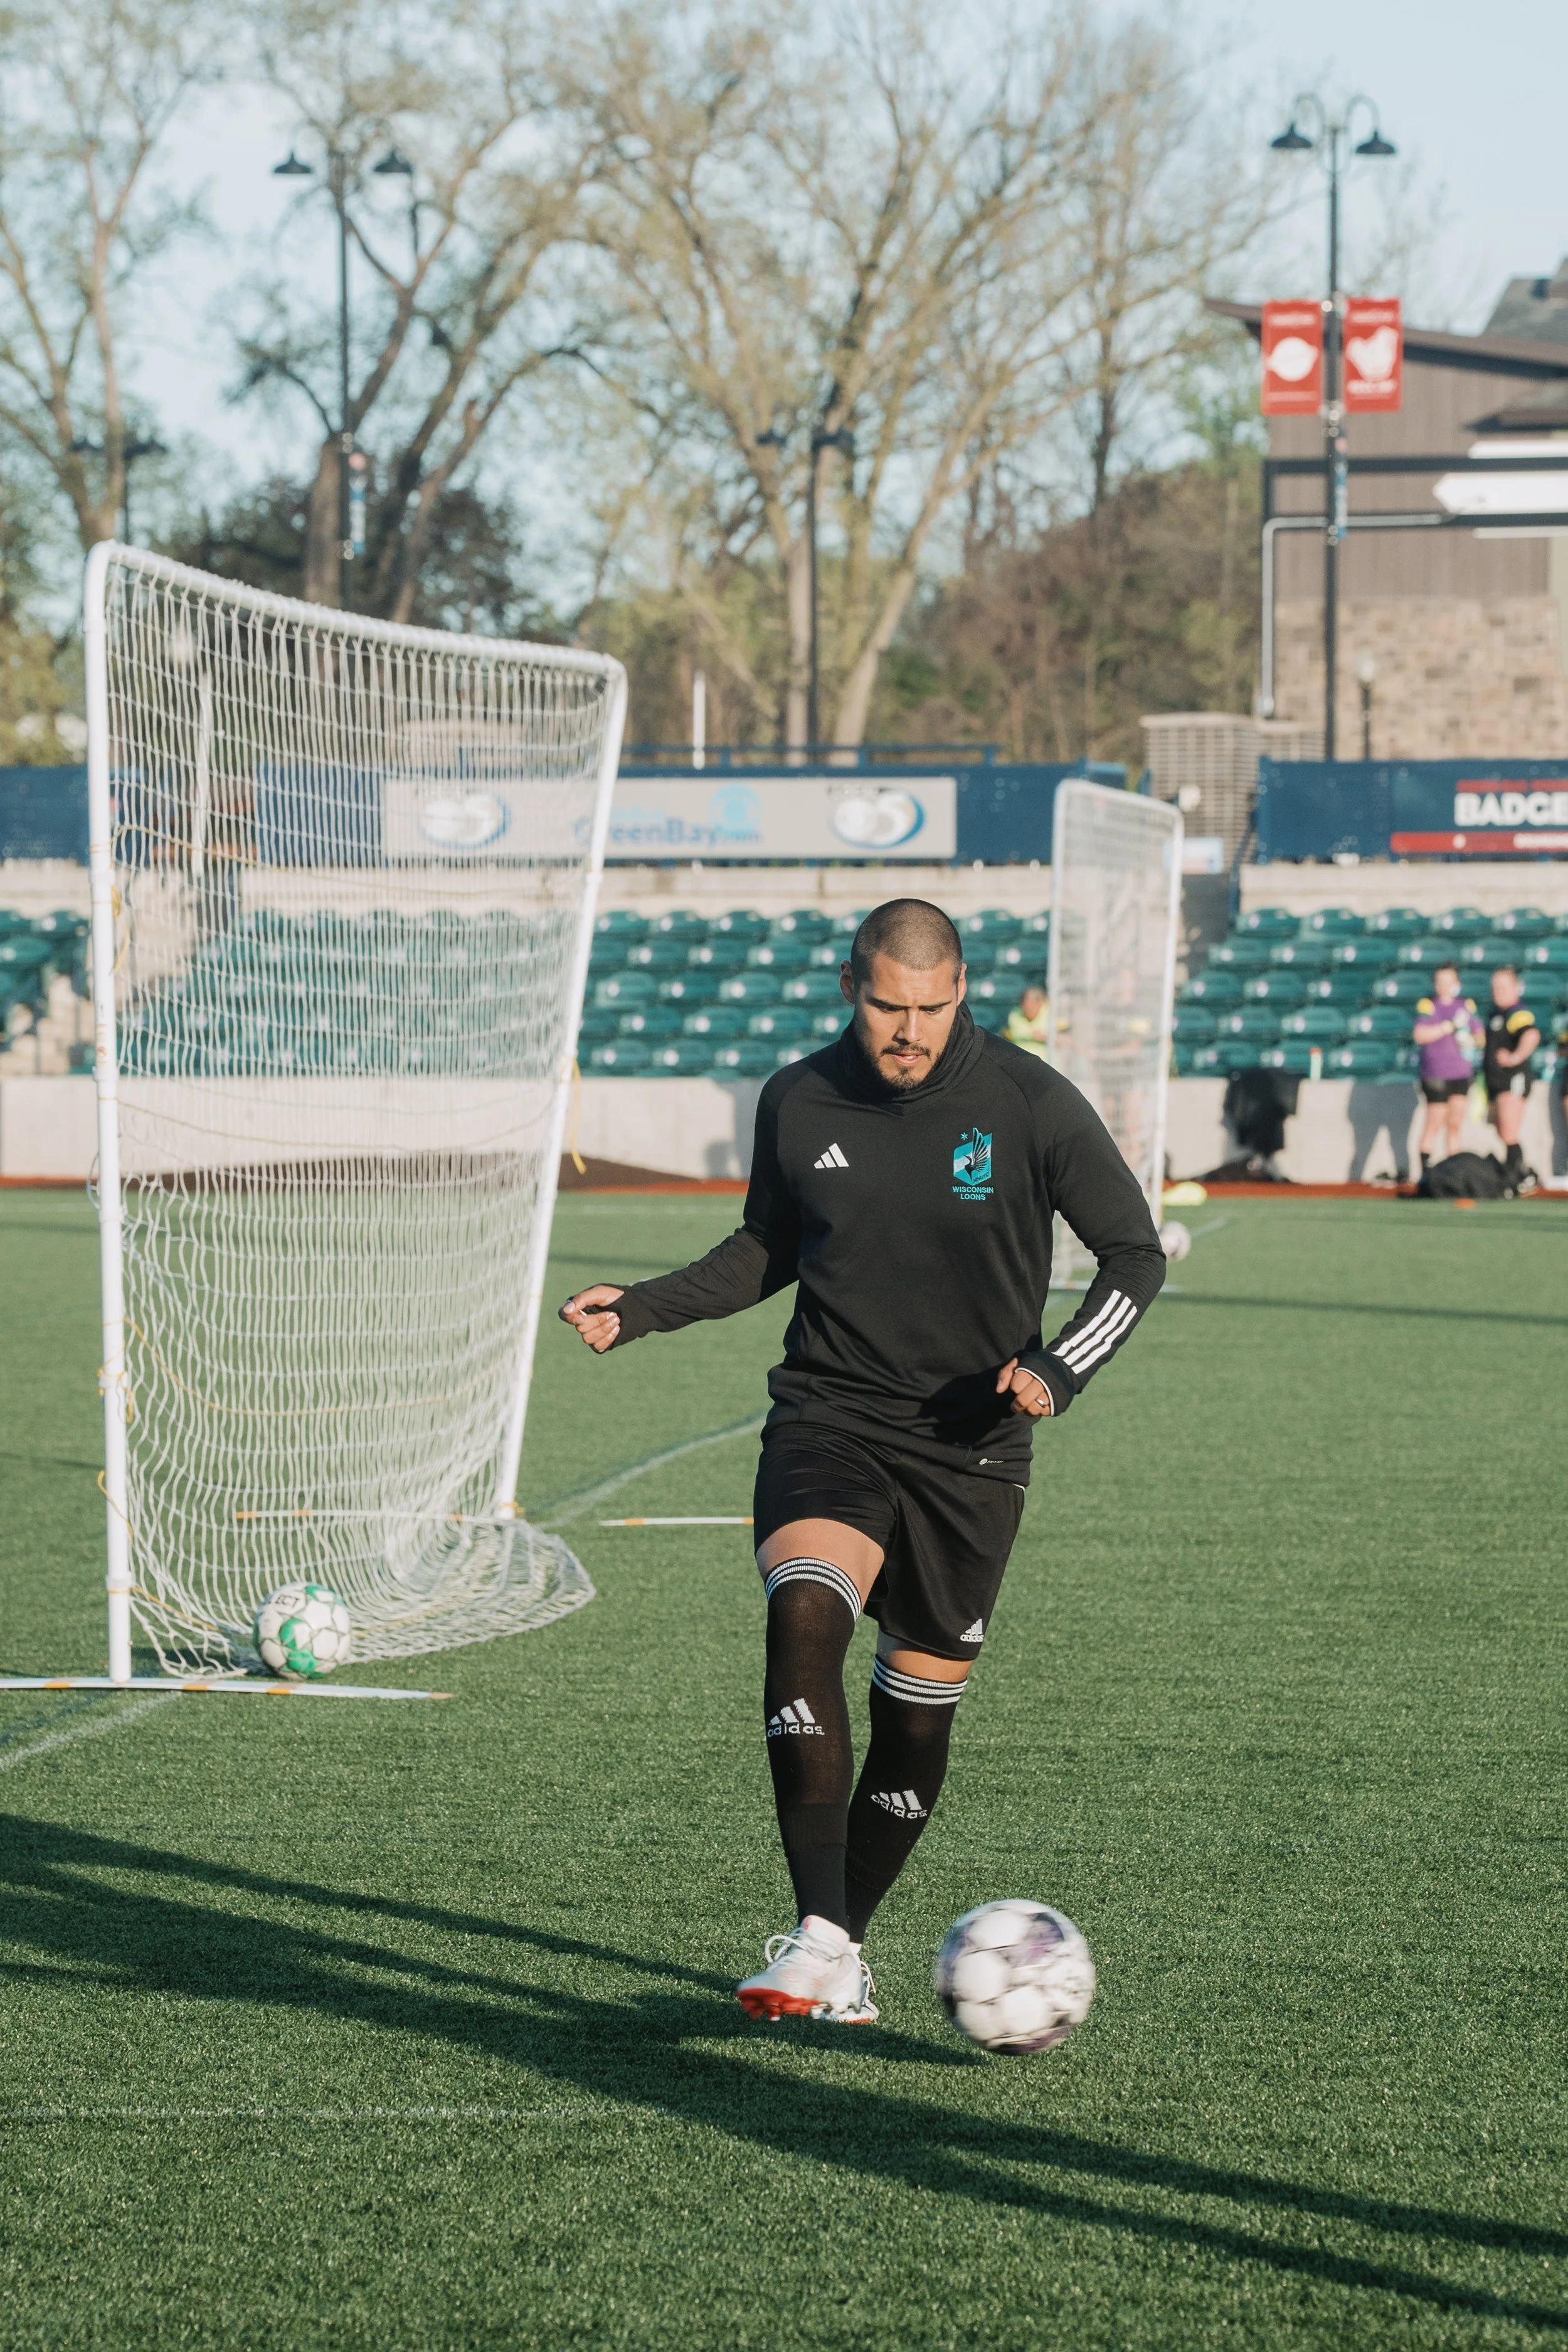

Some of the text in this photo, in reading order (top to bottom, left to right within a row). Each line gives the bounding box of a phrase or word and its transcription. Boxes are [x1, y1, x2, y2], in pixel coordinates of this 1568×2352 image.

[960, 1633, 984, 1642] adidas
[768, 1723, 825, 1737] adidas
[871, 1794, 928, 1819] adidas
